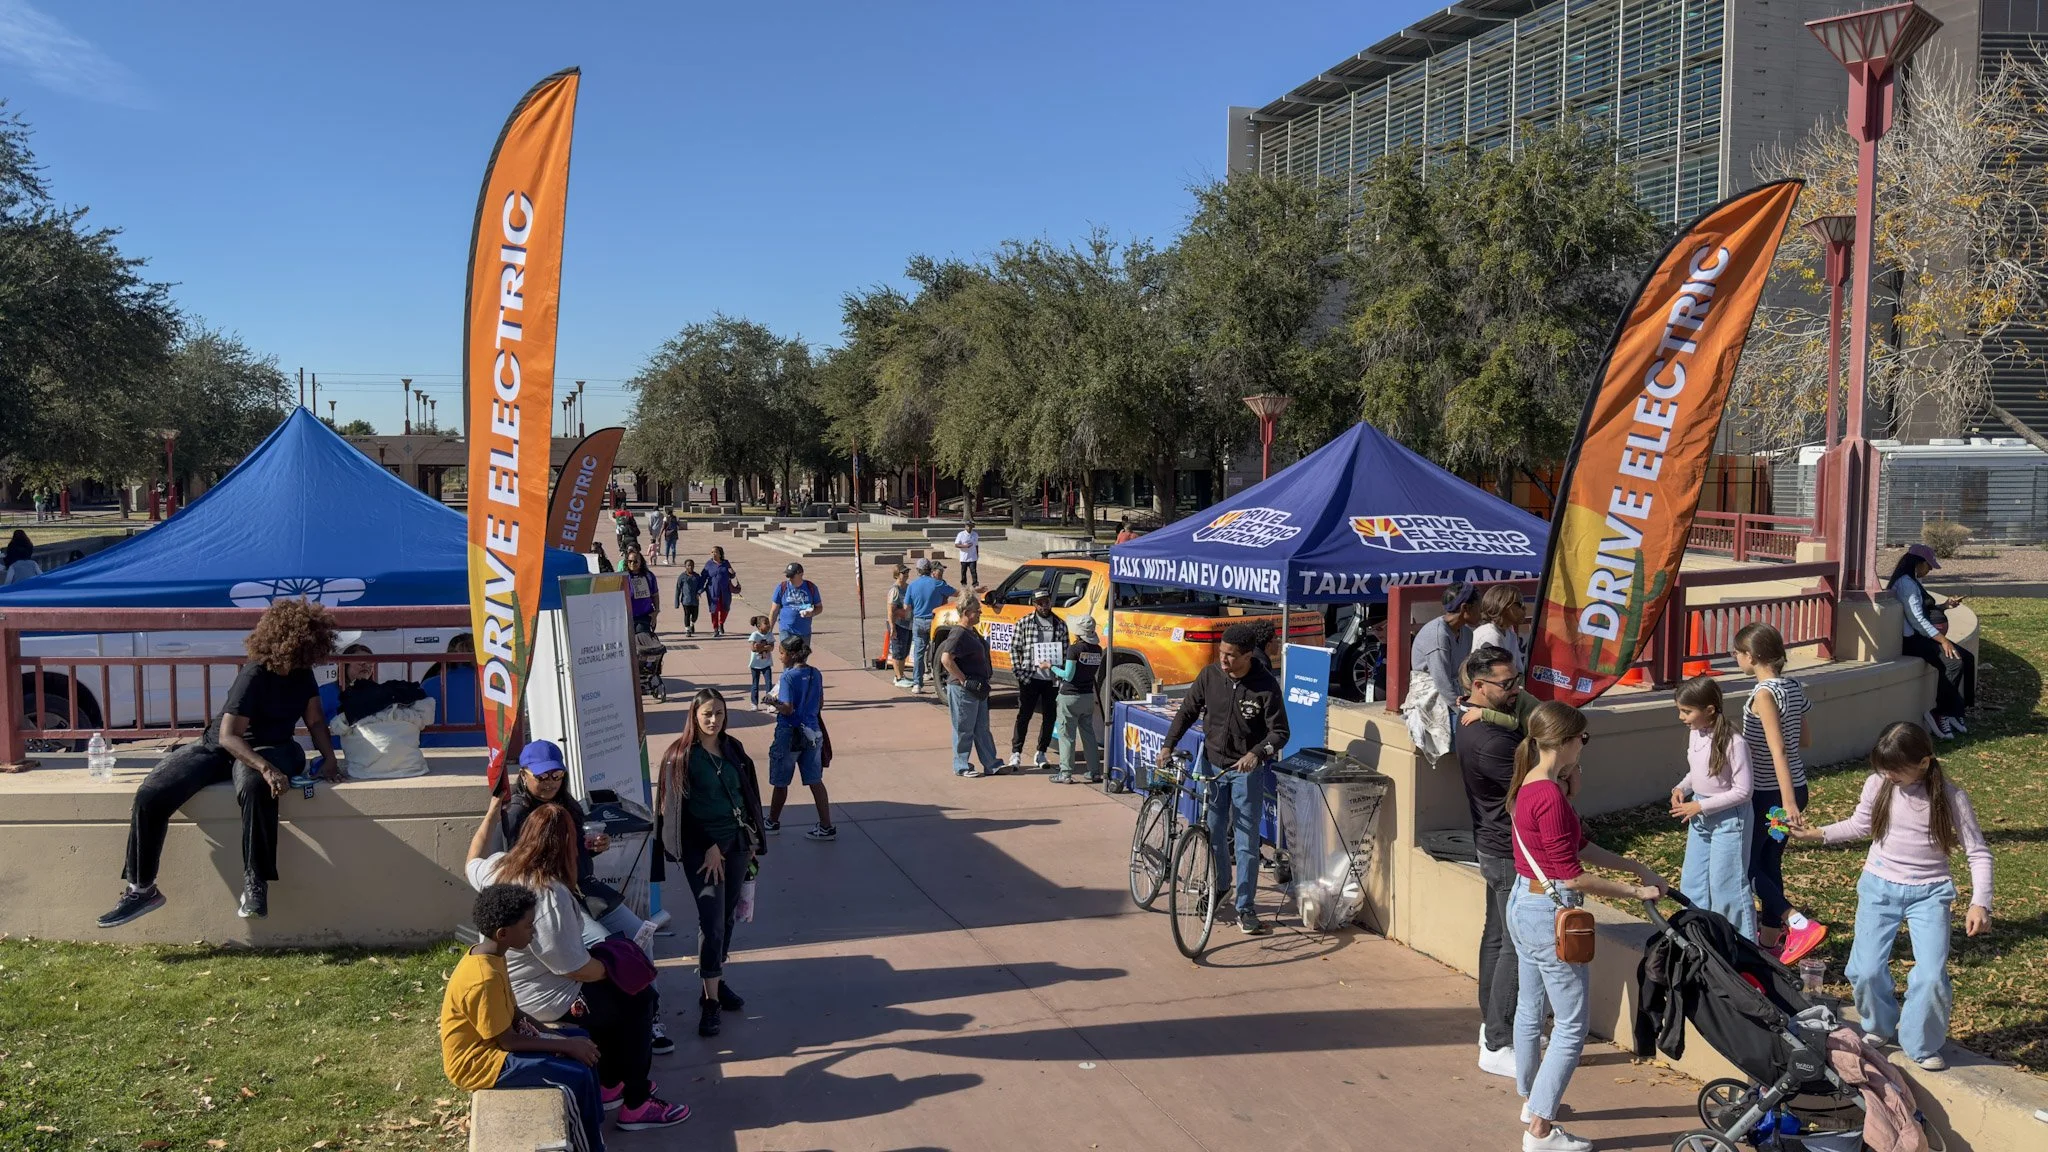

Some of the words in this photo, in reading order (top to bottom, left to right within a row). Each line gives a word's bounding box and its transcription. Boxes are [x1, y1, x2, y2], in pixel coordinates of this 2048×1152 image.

[488, 190, 534, 507] ELECTRIC
[1578, 485, 1653, 641] DRIVE
[1618, 243, 1730, 481] ELECTRIC
[562, 455, 597, 541] ELECTRIC
[1238, 510, 1287, 524] DRIVE
[1395, 518, 1471, 531] DRIVE
[1223, 521, 1298, 538] ELECTRIC
[1403, 529, 1526, 545] ELECTRIC
[1211, 530, 1275, 546] ARIZONA
[1415, 541, 1530, 555] ARIZONA
[1113, 556, 1140, 578] TALK
[1142, 558, 1176, 581] WITH
[1178, 560, 1200, 584] AN
[1200, 563, 1219, 587] EV
[1221, 565, 1280, 595] OWNER
[1299, 571, 1372, 595] TALK
[483, 514, 519, 707] DRIVE
[991, 623, 1013, 633] DRIVE
[991, 632, 1012, 642] ELEC
[601, 642, 623, 651] AERICN
[991, 641, 1011, 651] ARIZ
